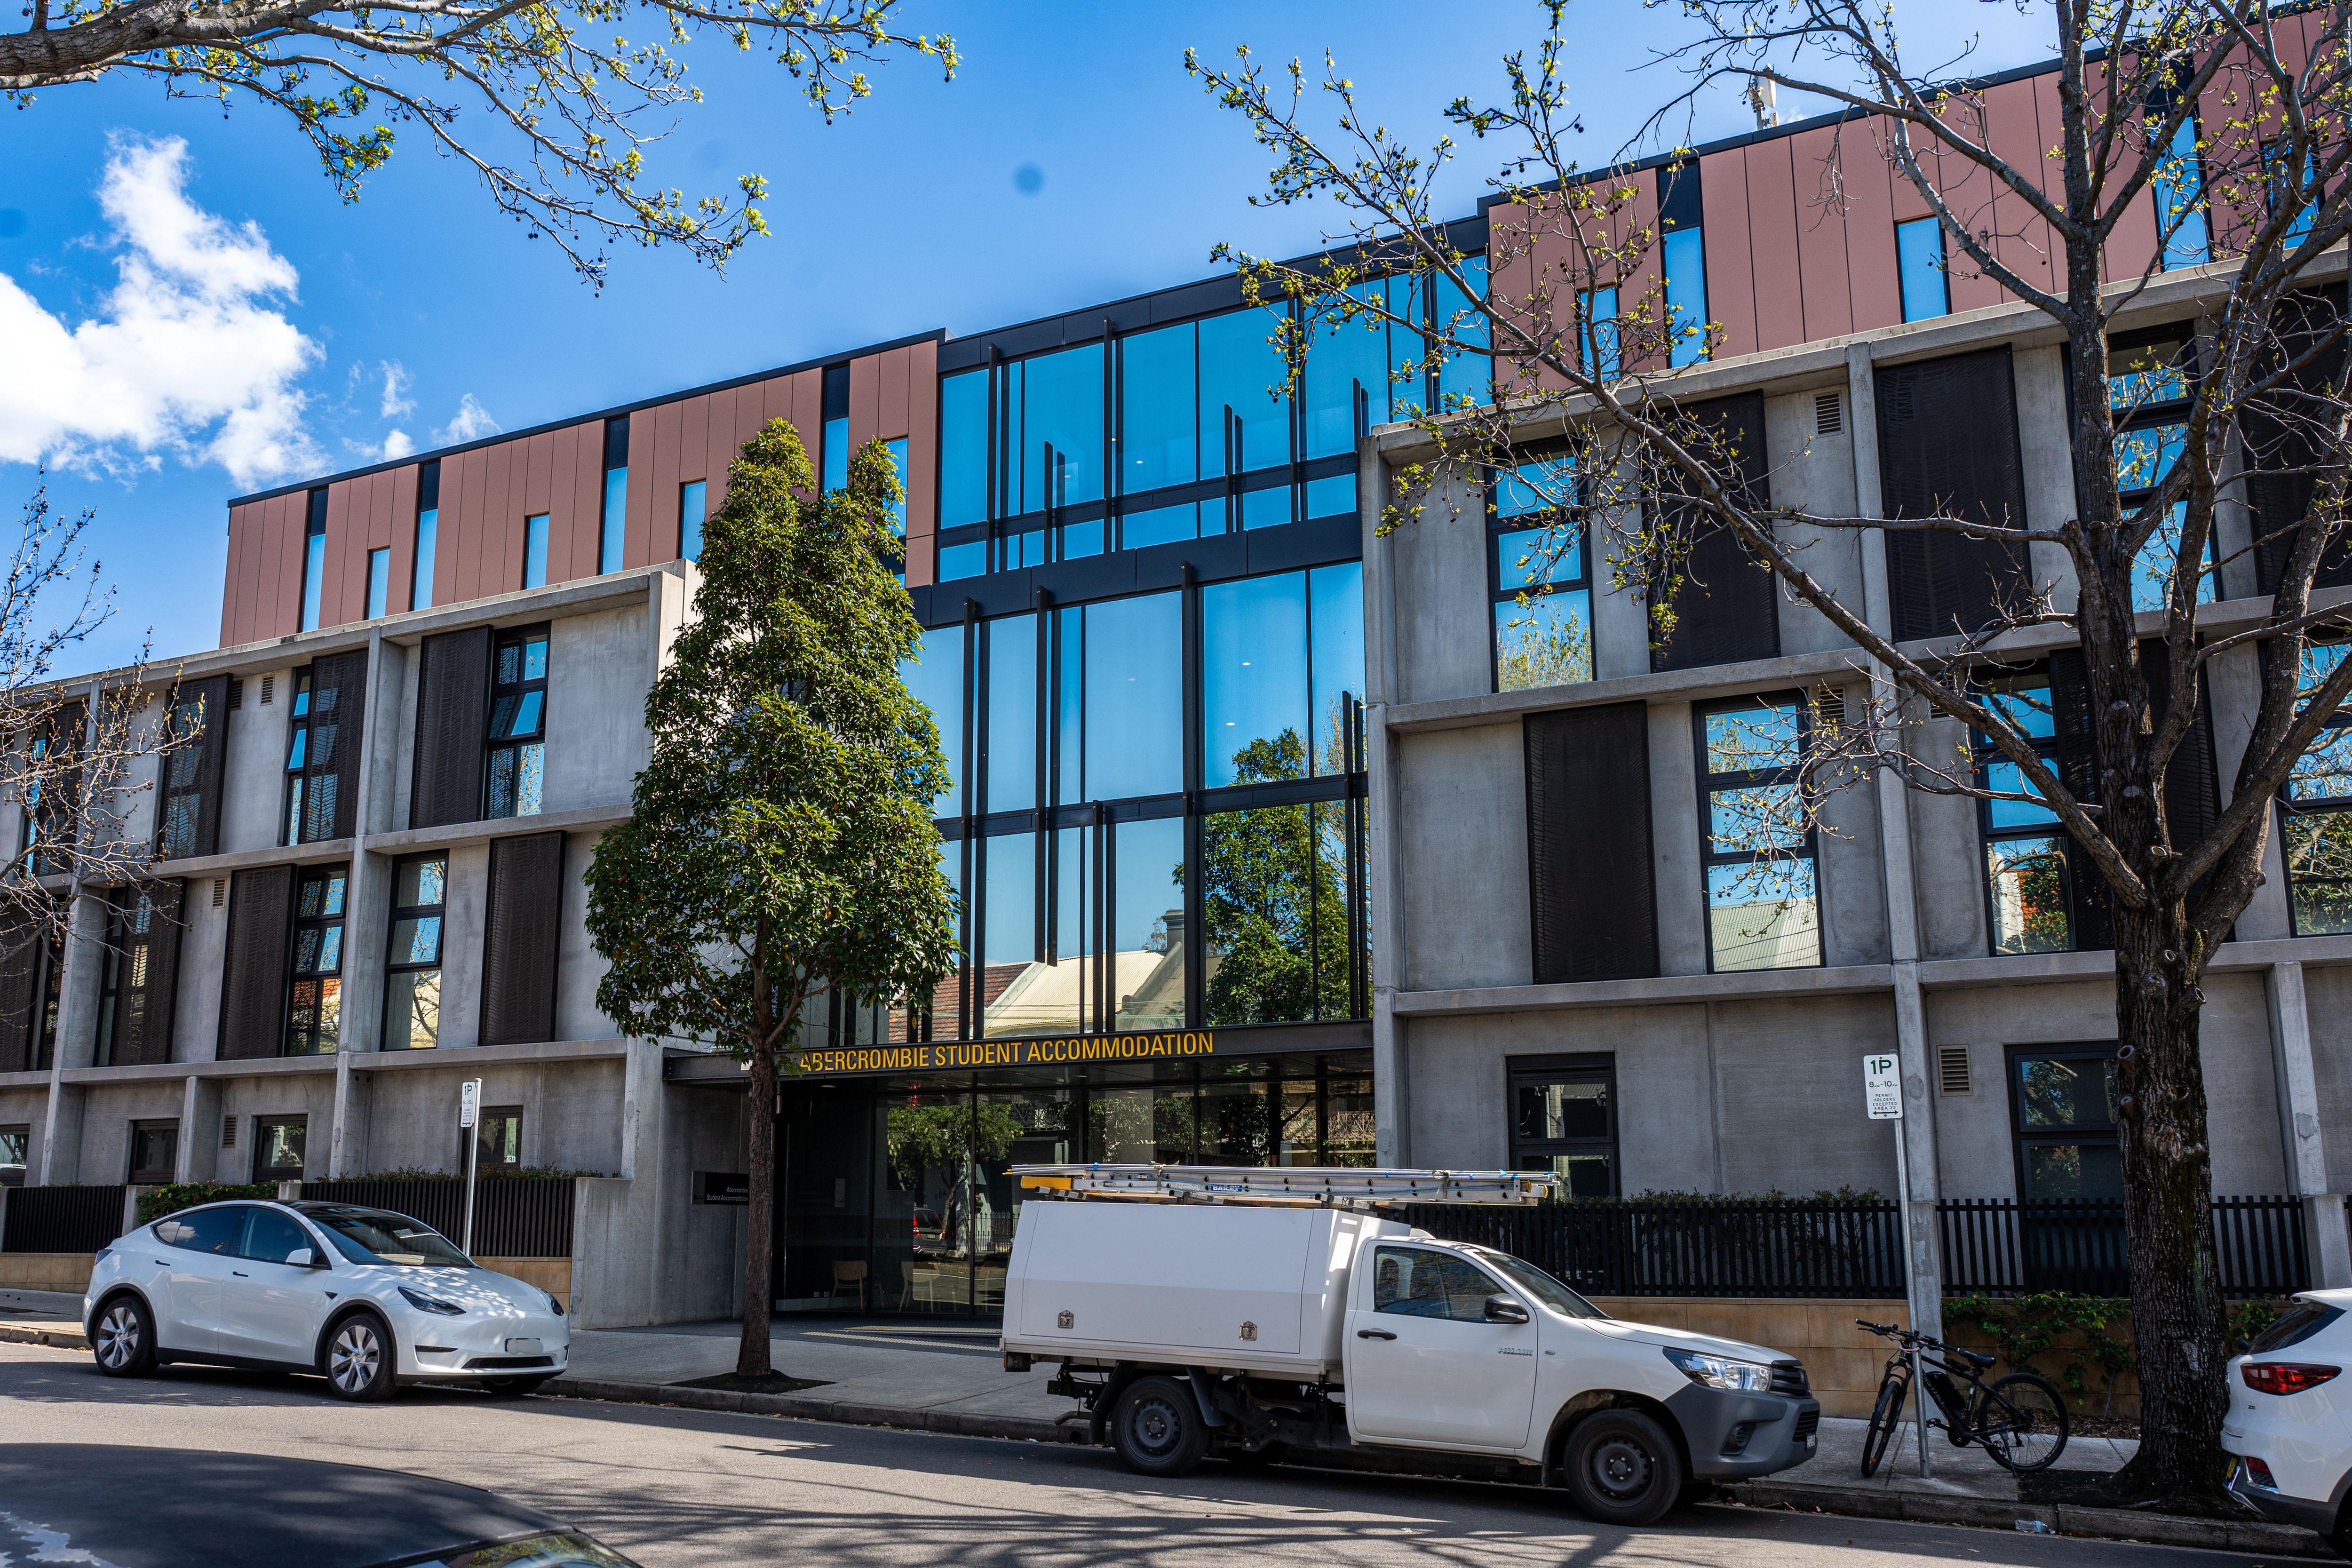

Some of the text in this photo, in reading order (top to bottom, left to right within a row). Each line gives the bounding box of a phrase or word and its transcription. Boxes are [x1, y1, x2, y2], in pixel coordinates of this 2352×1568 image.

[800, 1033, 1213, 1072] ABERCROMBIE STUDENT ACCOMMODATION
[1870, 1059, 1892, 1075] 1P
[465, 1084, 472, 1095] 1P
[1498, 1347, 1534, 1356] HILUX
